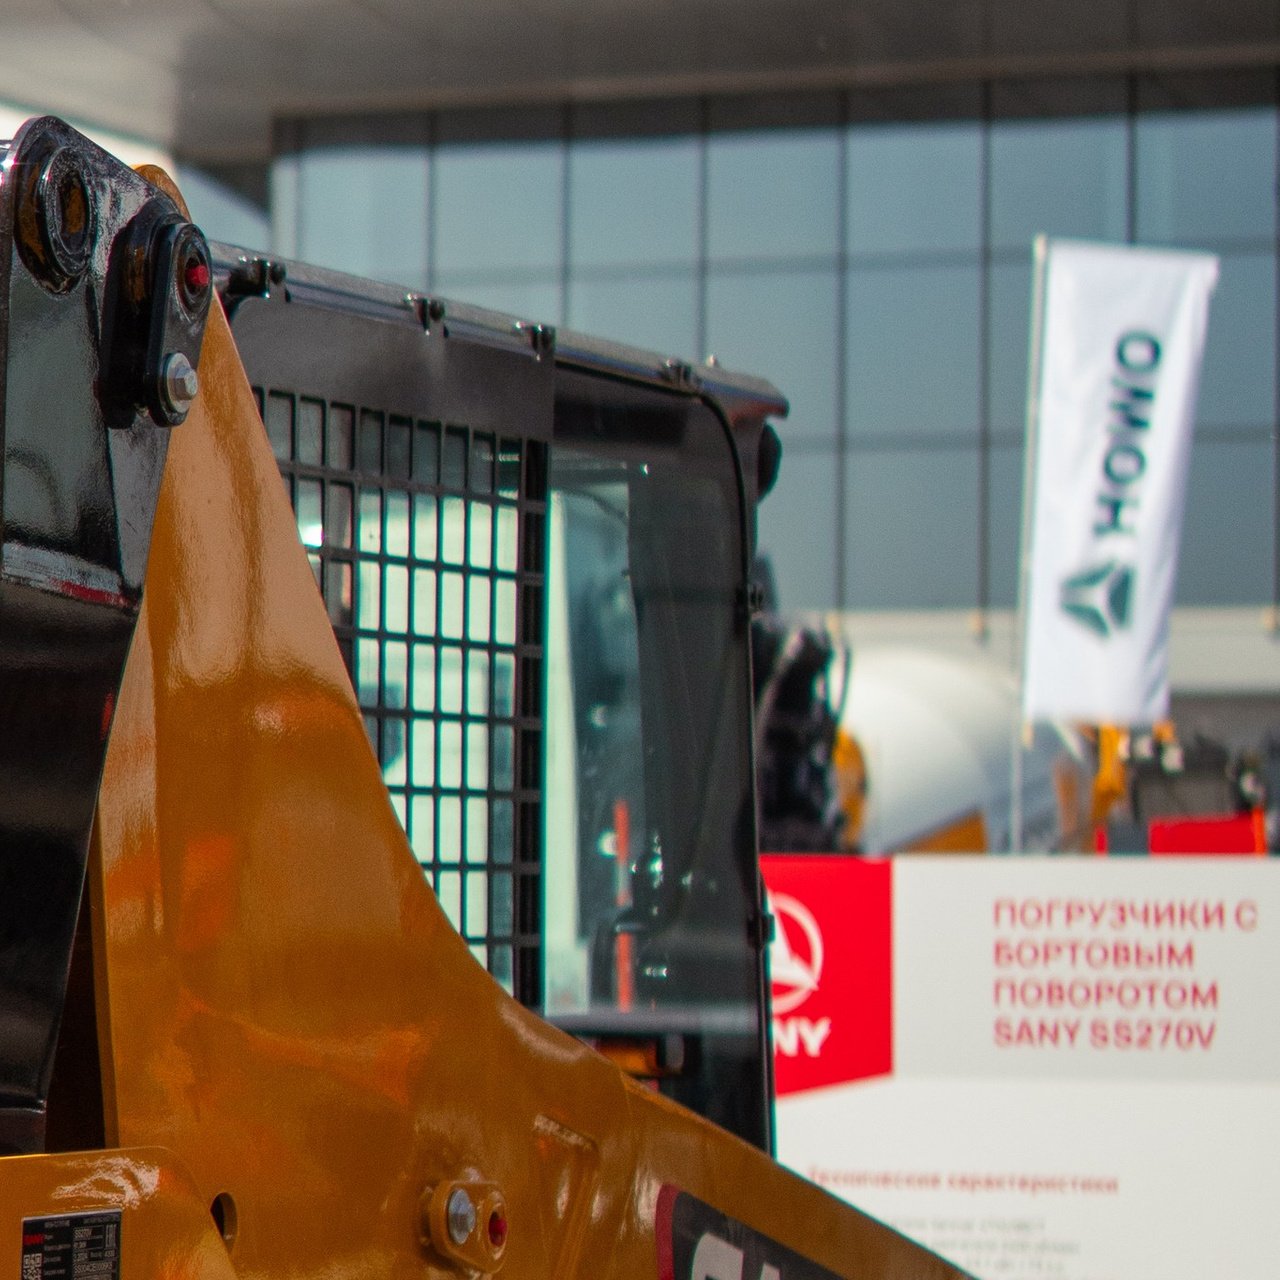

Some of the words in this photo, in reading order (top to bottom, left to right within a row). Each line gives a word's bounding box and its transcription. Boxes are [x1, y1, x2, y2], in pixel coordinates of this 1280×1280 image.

[1094, 330, 1161, 535] HOWO
[994, 898, 1225, 932] ПОГРУЗЧИКИ
[994, 938, 1195, 970] БОРТОВЫМ
[994, 979, 1219, 1011] ПОВОРОТОМ
[994, 1018, 1081, 1050] SANY
[1089, 1018, 1217, 1051] SS270V
